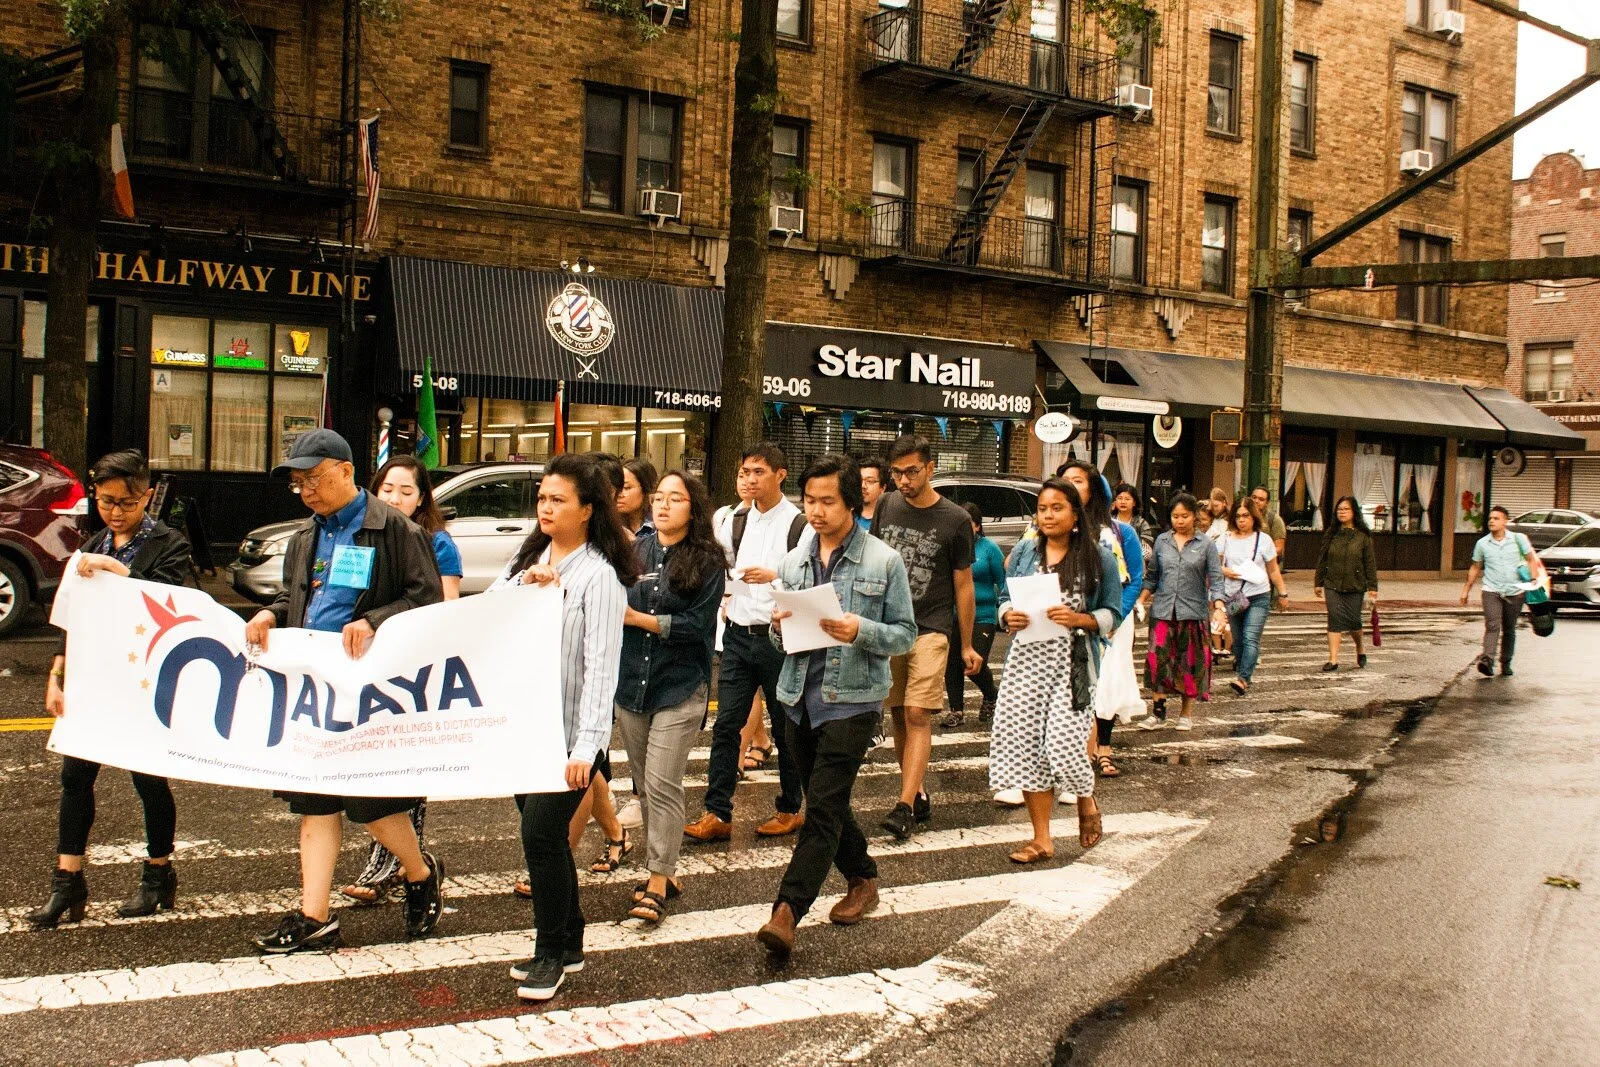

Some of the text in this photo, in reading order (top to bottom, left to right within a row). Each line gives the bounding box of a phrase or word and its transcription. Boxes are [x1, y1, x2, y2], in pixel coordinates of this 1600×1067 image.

[0, 243, 371, 301] TH HALFWAY LINE
[558, 330, 607, 349] NEW YORK CUTS
[164, 350, 206, 363] GUINNESS
[281, 354, 319, 366] GUINNESS
[818, 344, 995, 388] Star Nail PLUS
[156, 373, 168, 386] A
[412, 374, 458, 391] 5-08
[762, 375, 811, 398] 59-06
[654, 390, 722, 408] 718-606-6
[942, 390, 1032, 414] 718-980-8189
[350, 725, 391, 740] AGAINST
[392, 722, 433, 734] KILLINGS
[435, 721, 441, 731] &
[443, 716, 508, 731] DICTATORSHIP
[387, 740, 397, 748] IN
[400, 738, 417, 748] THE
[419, 733, 474, 747] PHILIPPINES
[167, 748, 311, 782] www.malayamovement.com
[322, 764, 470, 782] malayamovement@gmail.com
